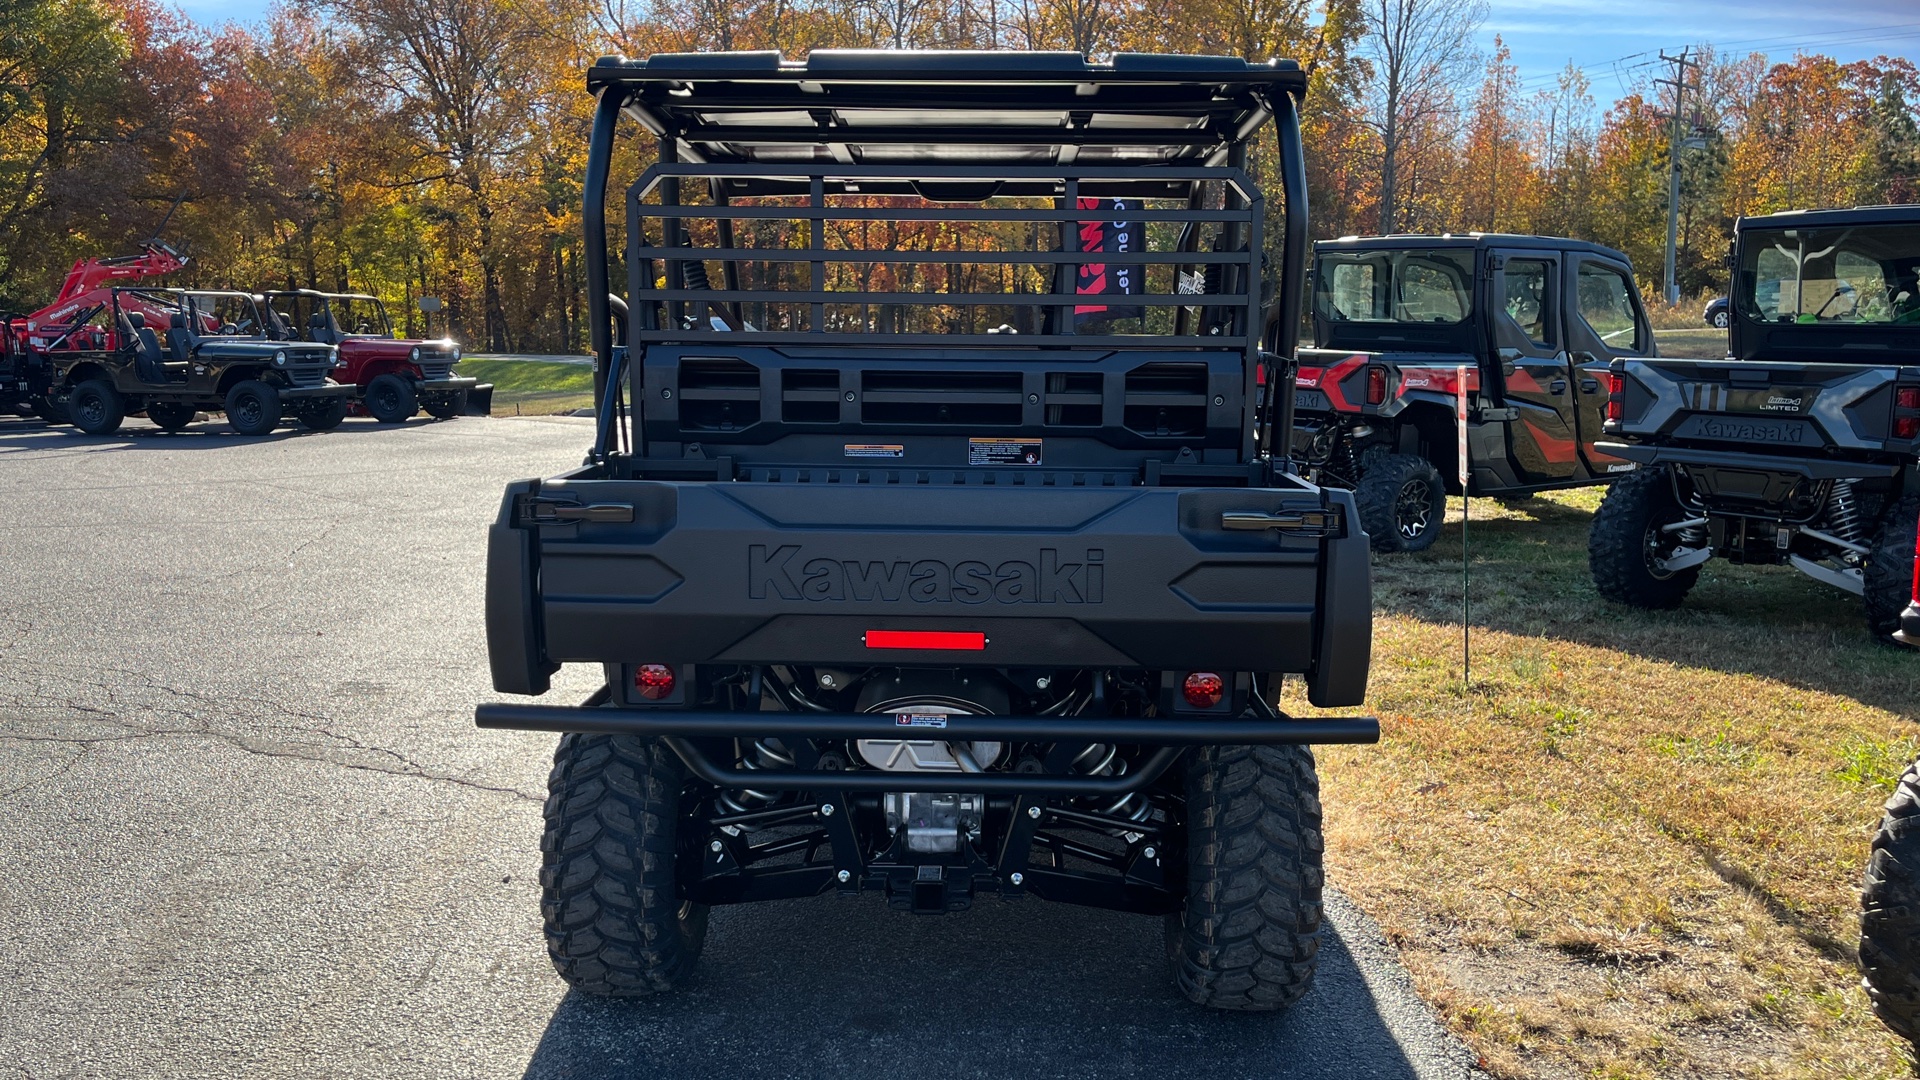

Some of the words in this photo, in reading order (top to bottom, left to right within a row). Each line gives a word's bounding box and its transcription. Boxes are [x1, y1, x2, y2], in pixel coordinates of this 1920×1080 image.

[50, 303, 79, 320] Mahindra
[1759, 404, 1799, 412] LIMITED
[1695, 418, 1803, 442] Kawasaki
[1607, 462, 1636, 472] Kawasaki
[748, 544, 1105, 604] Kawasaki
